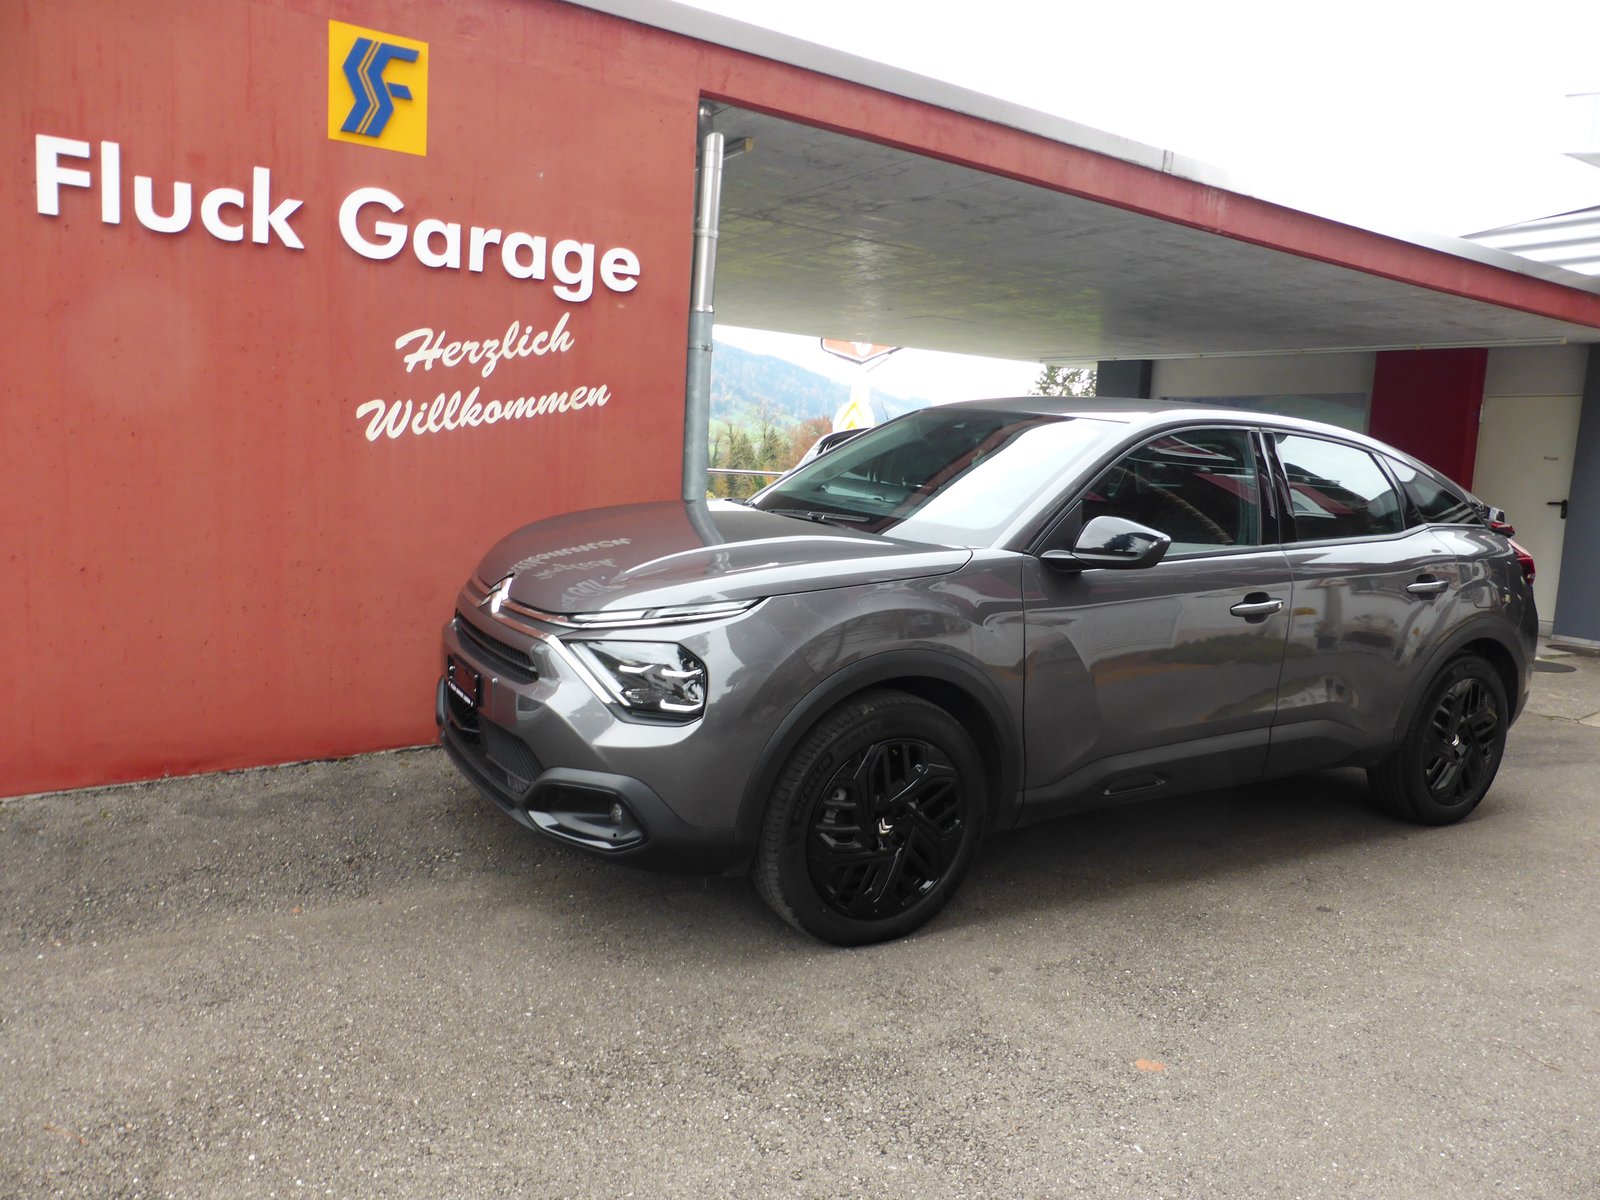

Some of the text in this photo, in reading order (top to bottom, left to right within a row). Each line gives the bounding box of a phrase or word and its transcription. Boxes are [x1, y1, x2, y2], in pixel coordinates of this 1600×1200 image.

[35, 133, 641, 303] Fluck Garage
[395, 312, 575, 379] Herzlich
[356, 382, 611, 442] Willkommen
